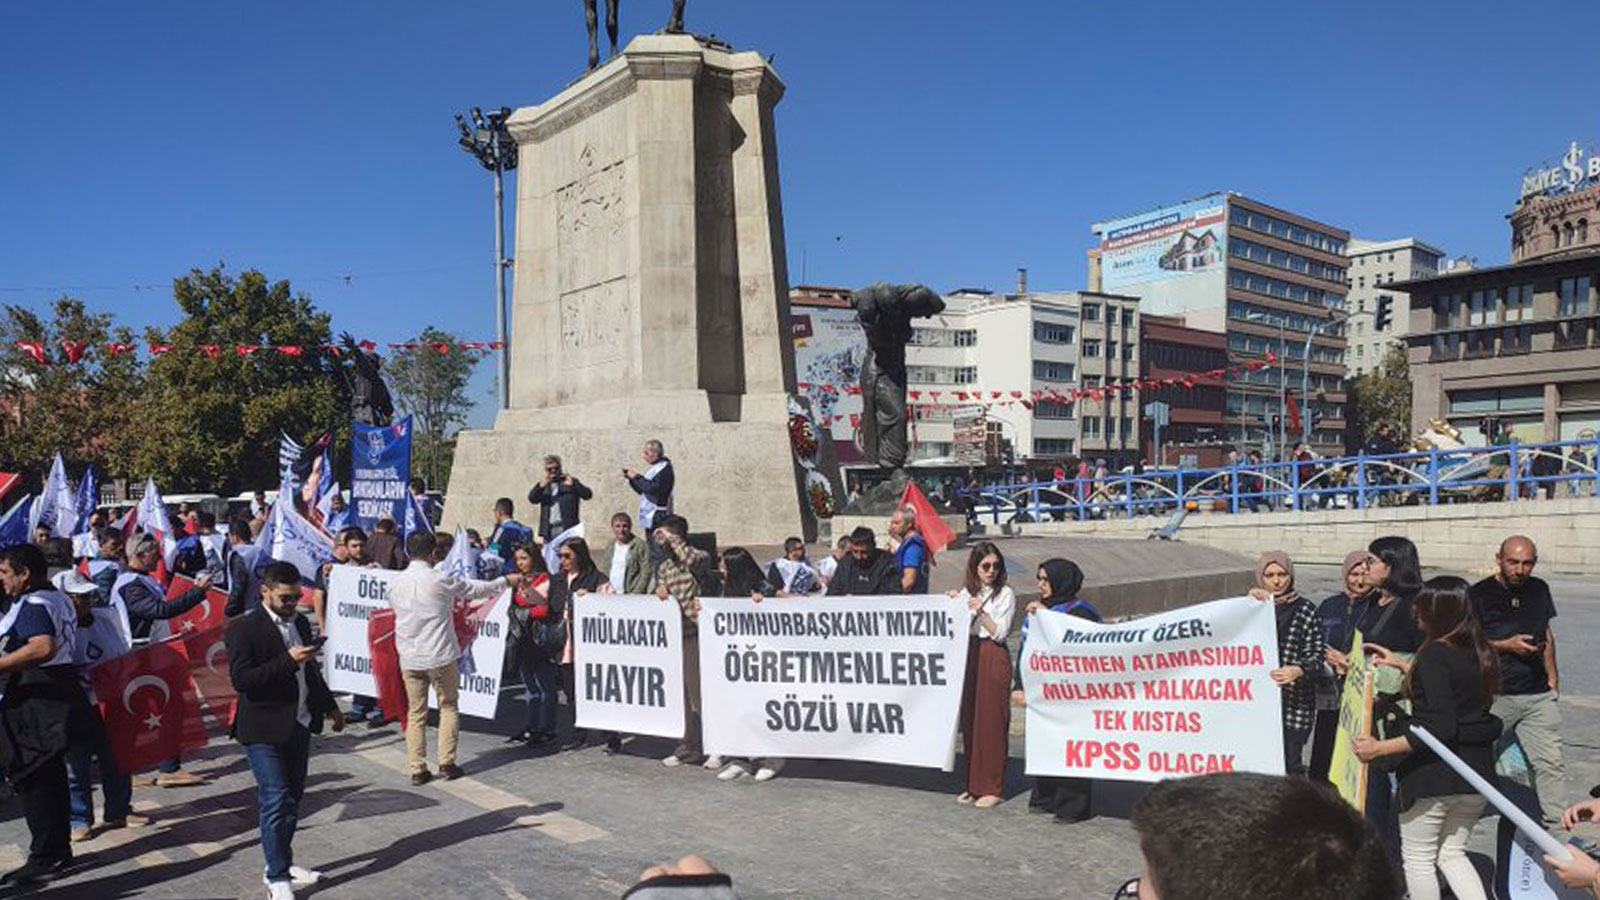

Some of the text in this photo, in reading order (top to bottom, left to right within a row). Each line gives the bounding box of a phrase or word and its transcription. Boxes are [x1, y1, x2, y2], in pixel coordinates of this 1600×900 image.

[582, 612, 668, 648] MÜLAKATA
[1062, 618, 1213, 643] MAHMUT ÖZER:
[724, 644, 947, 686] ÖĞRETMENLERE
[1030, 645, 1264, 673] ÖĞRETMEN ATAMASINDA
[585, 663, 666, 708] HAYIR
[1043, 678, 1253, 701] MÜLAKAT KALKACAK
[765, 694, 905, 734] SÖZÜ VAR
[1092, 710, 1201, 733] TEK KISTAS
[1065, 740, 1236, 774] KPSS OLACAK
